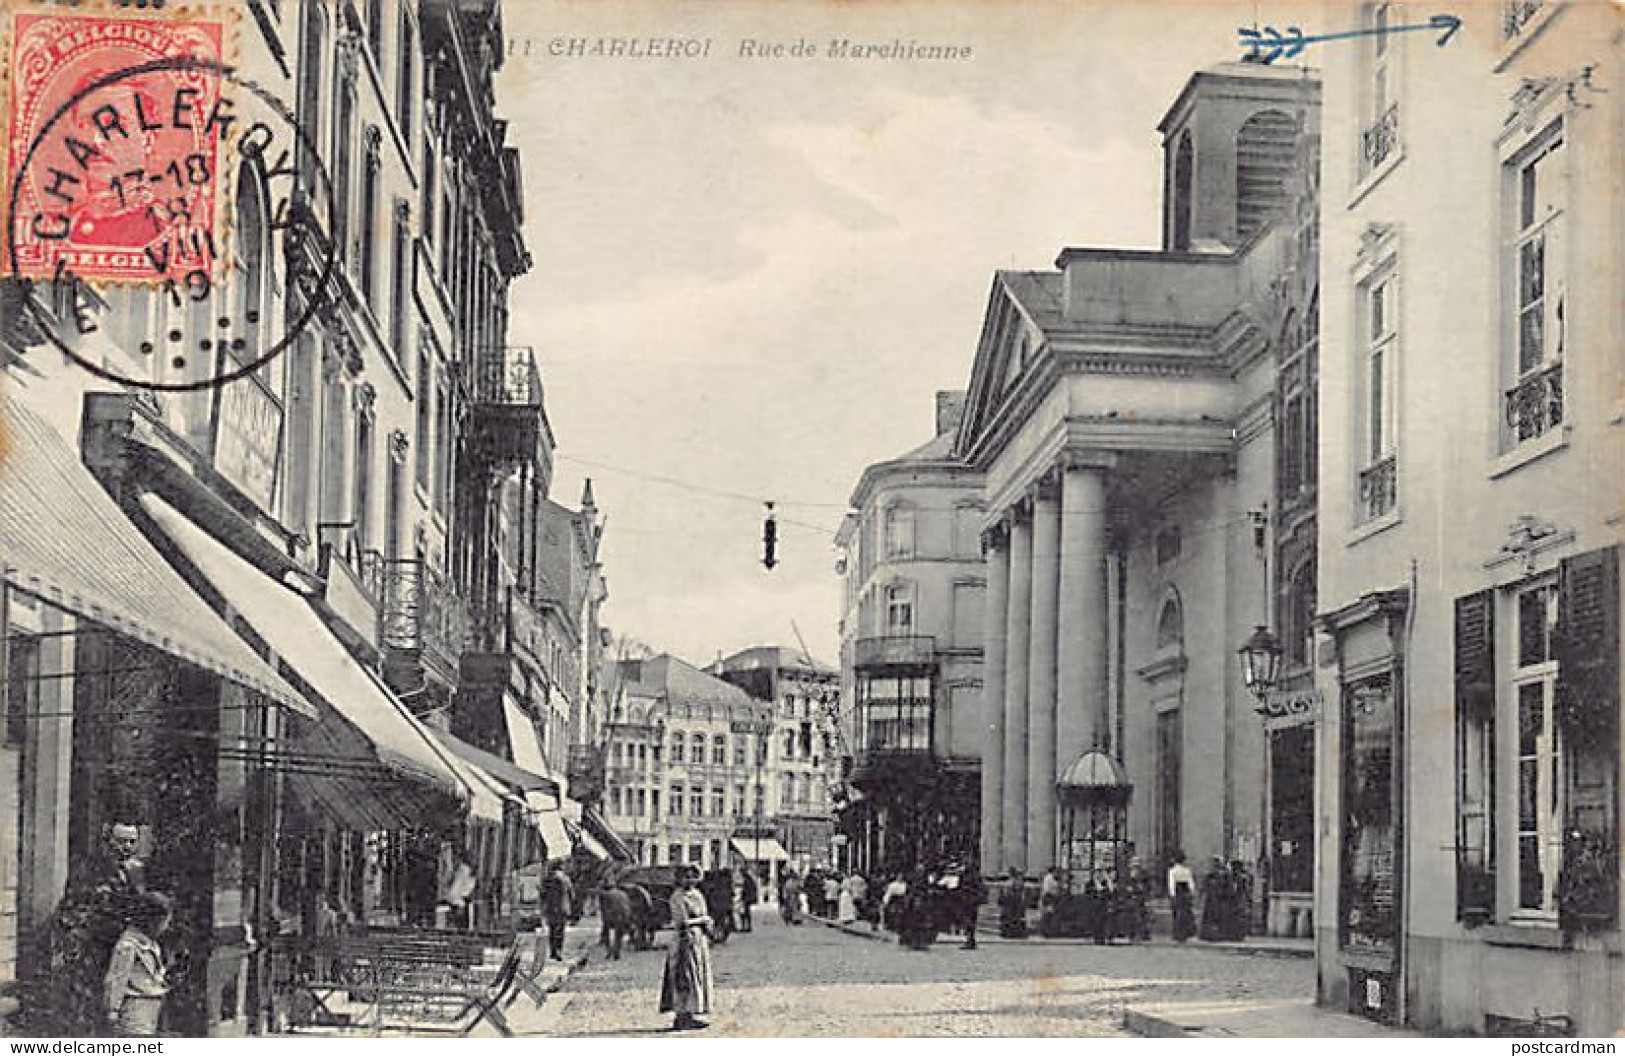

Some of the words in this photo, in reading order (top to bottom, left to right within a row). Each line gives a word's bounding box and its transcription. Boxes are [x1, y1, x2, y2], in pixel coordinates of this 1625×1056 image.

[109, 153, 210, 207] 17-18
[58, 251, 158, 268] BELGI
[163, 269, 211, 308] 19
